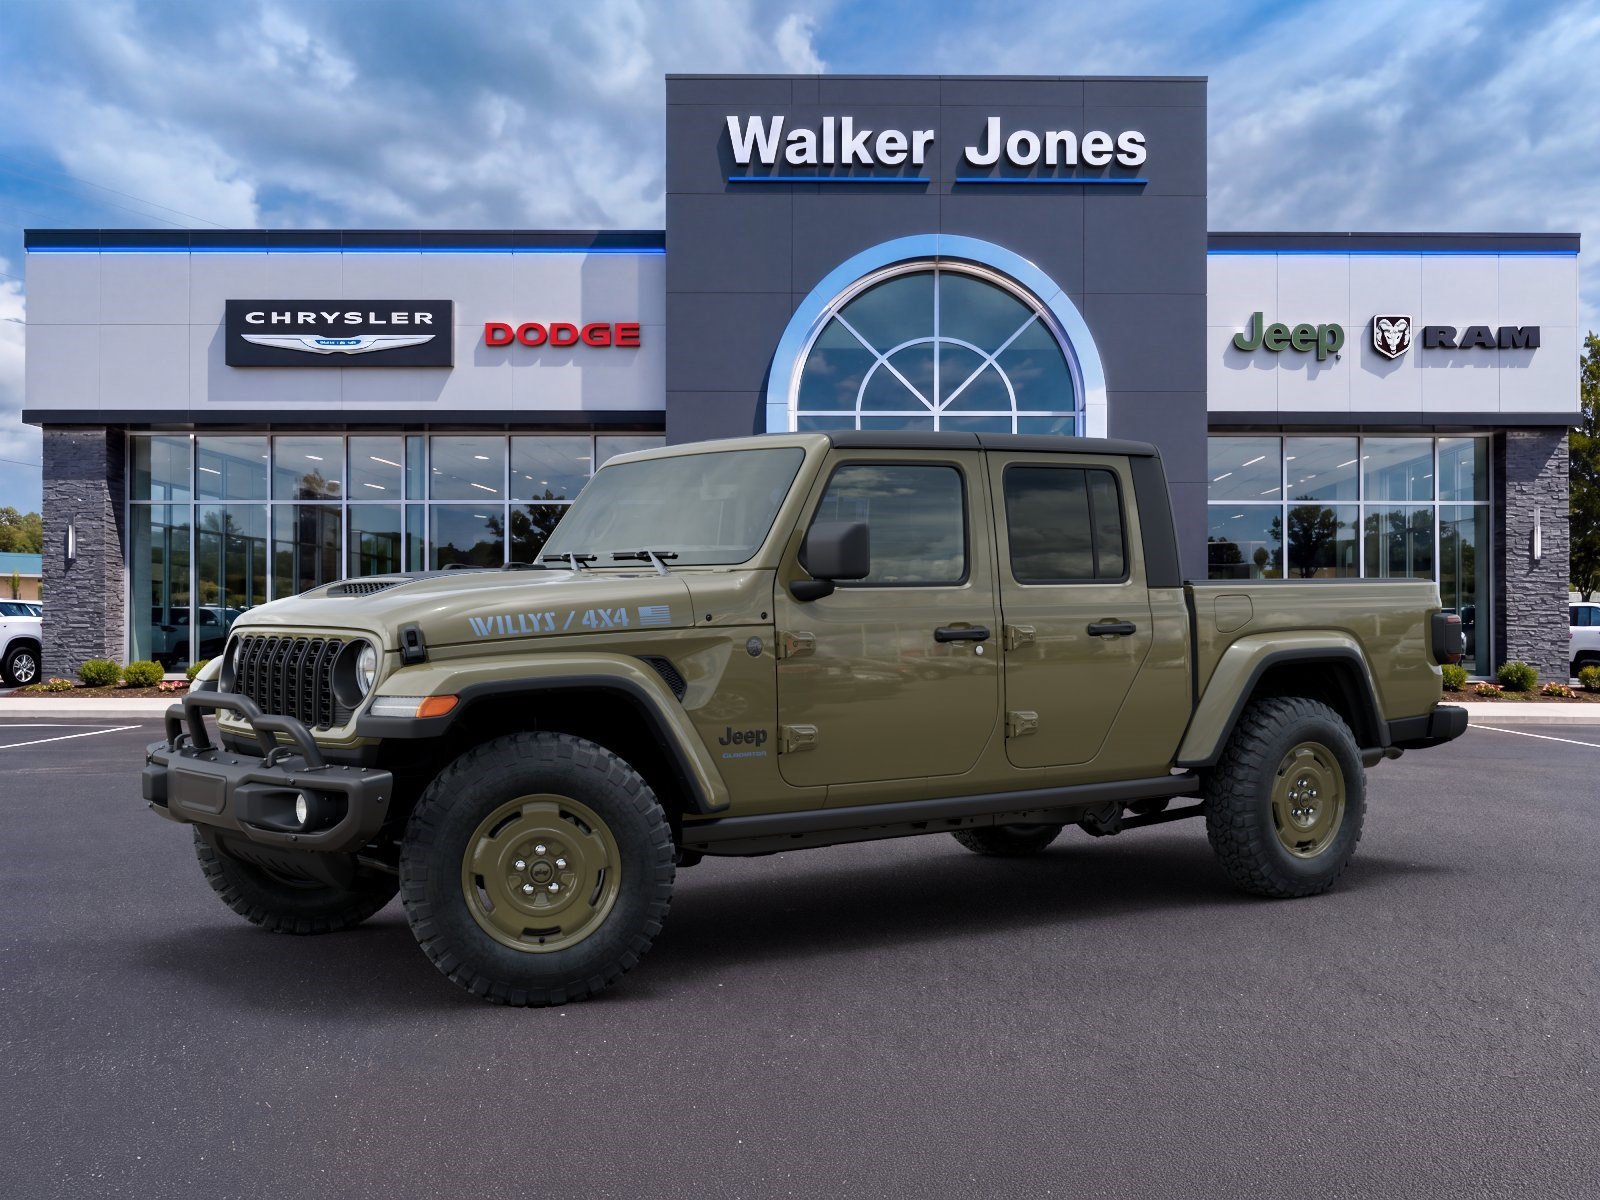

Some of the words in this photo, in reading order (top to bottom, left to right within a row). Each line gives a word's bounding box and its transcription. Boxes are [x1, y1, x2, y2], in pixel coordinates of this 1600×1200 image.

[726, 115, 935, 165] Walker
[964, 116, 1148, 166] Jones
[245, 311, 433, 325] CHRYSLER
[485, 322, 641, 347] DODGE
[1233, 311, 1345, 361] Jeep
[1424, 325, 1541, 349] RAM
[468, 611, 556, 637] WILLYS
[581, 607, 630, 629] 4X4
[718, 726, 768, 747] Jeep
